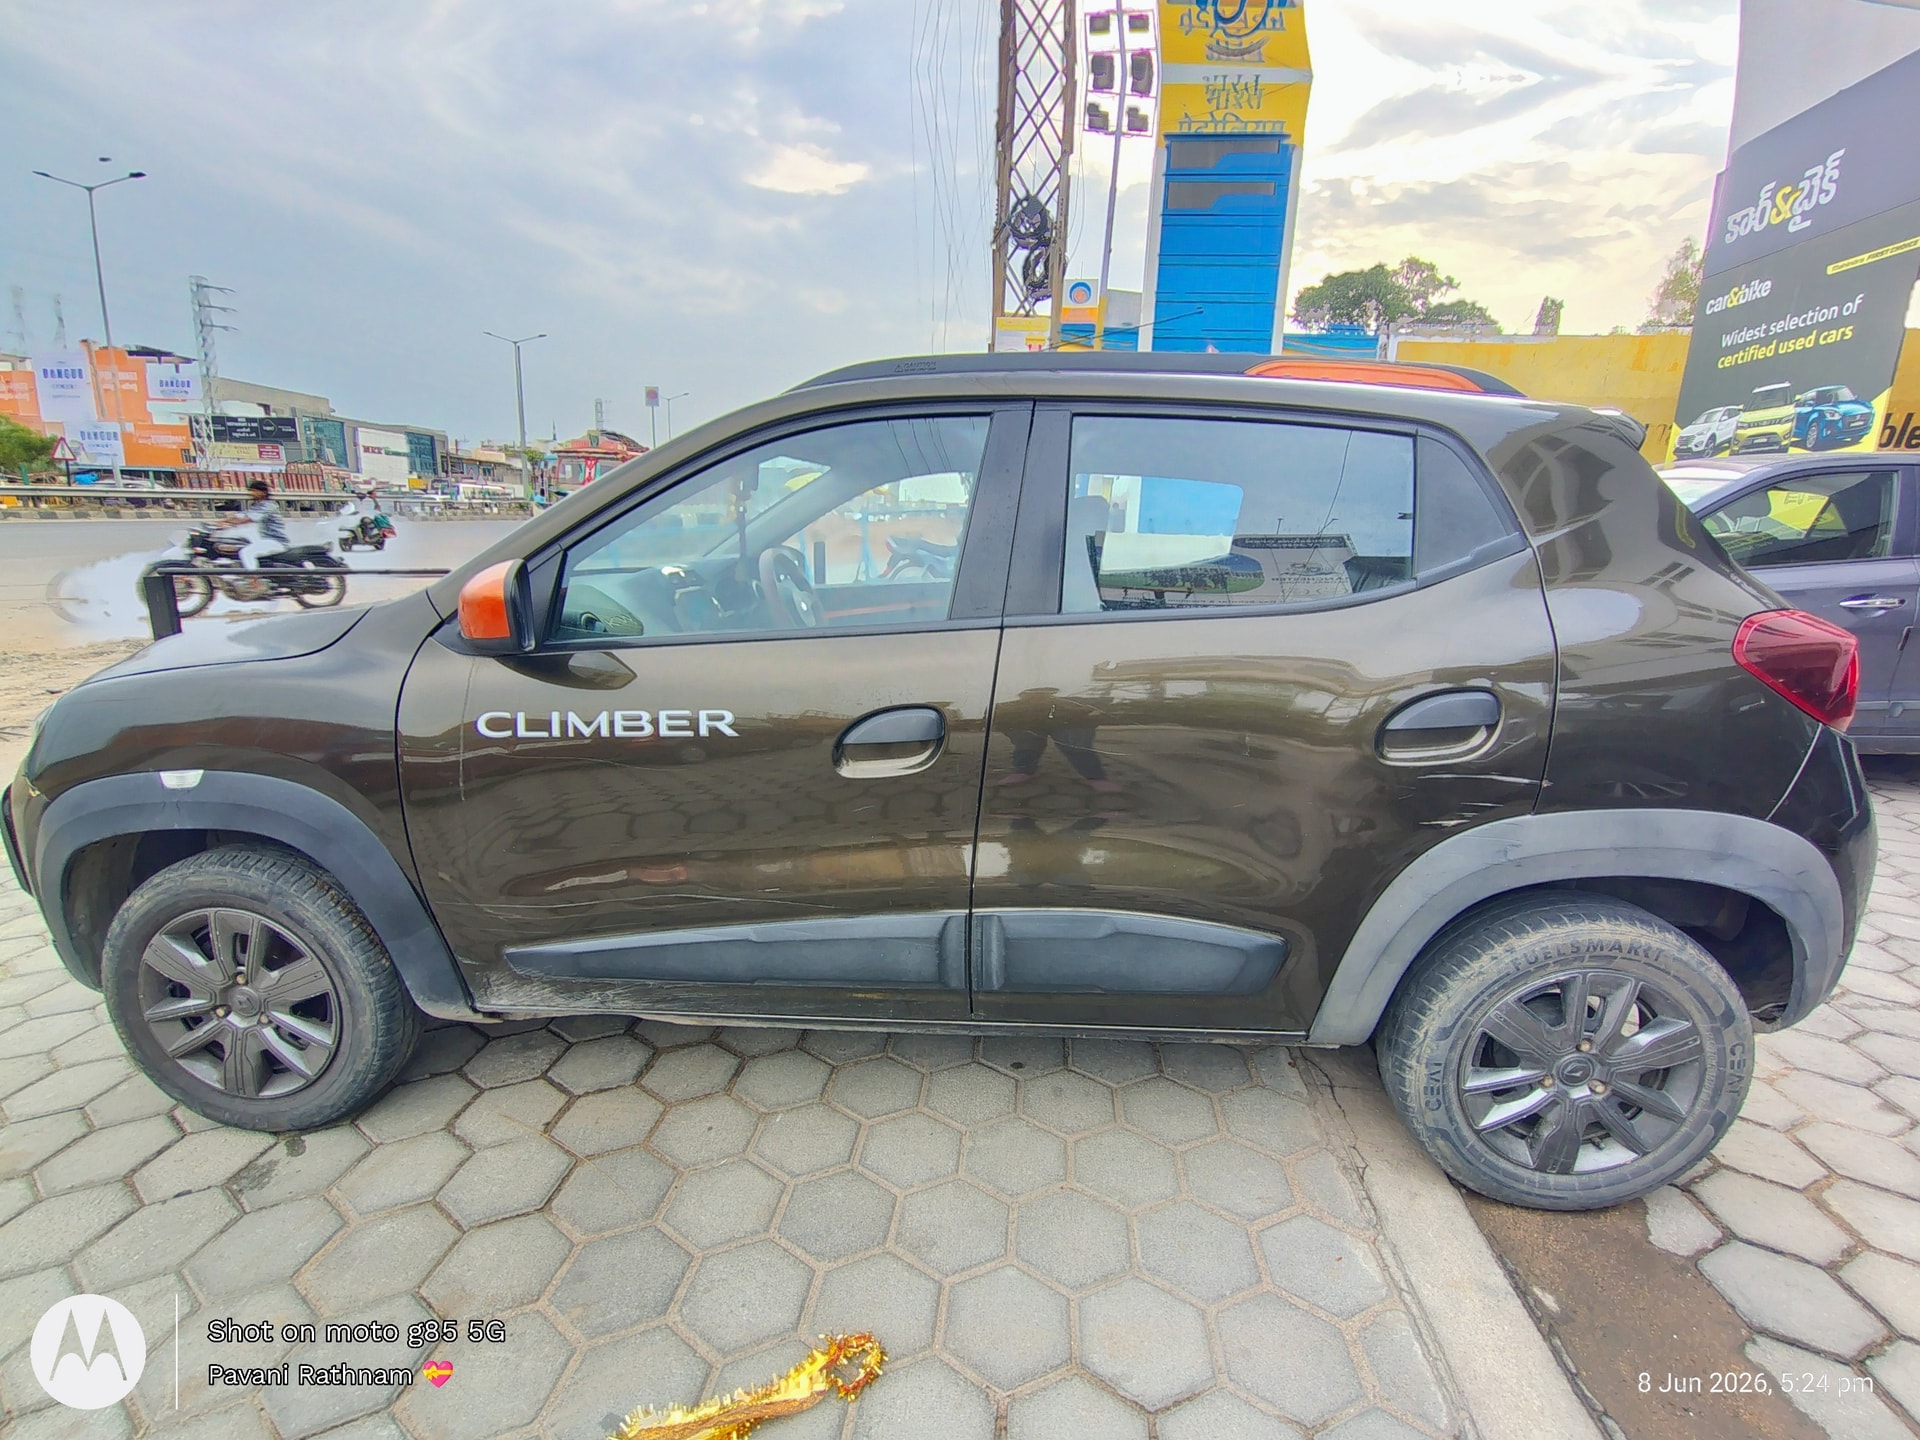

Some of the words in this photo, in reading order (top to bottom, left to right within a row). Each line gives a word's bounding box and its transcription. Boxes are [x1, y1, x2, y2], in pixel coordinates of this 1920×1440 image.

[1705, 279, 1772, 315] car&bike
[1721, 323, 1769, 348] Widest
[1768, 305, 1838, 336] selection
[1842, 293, 1864, 316] of
[1717, 339, 1777, 369] certified
[1778, 329, 1817, 354] used
[1819, 325, 1854, 345] cars
[475, 709, 741, 738] CLIMBER
[1727, 1041, 1746, 1095] CEAT
